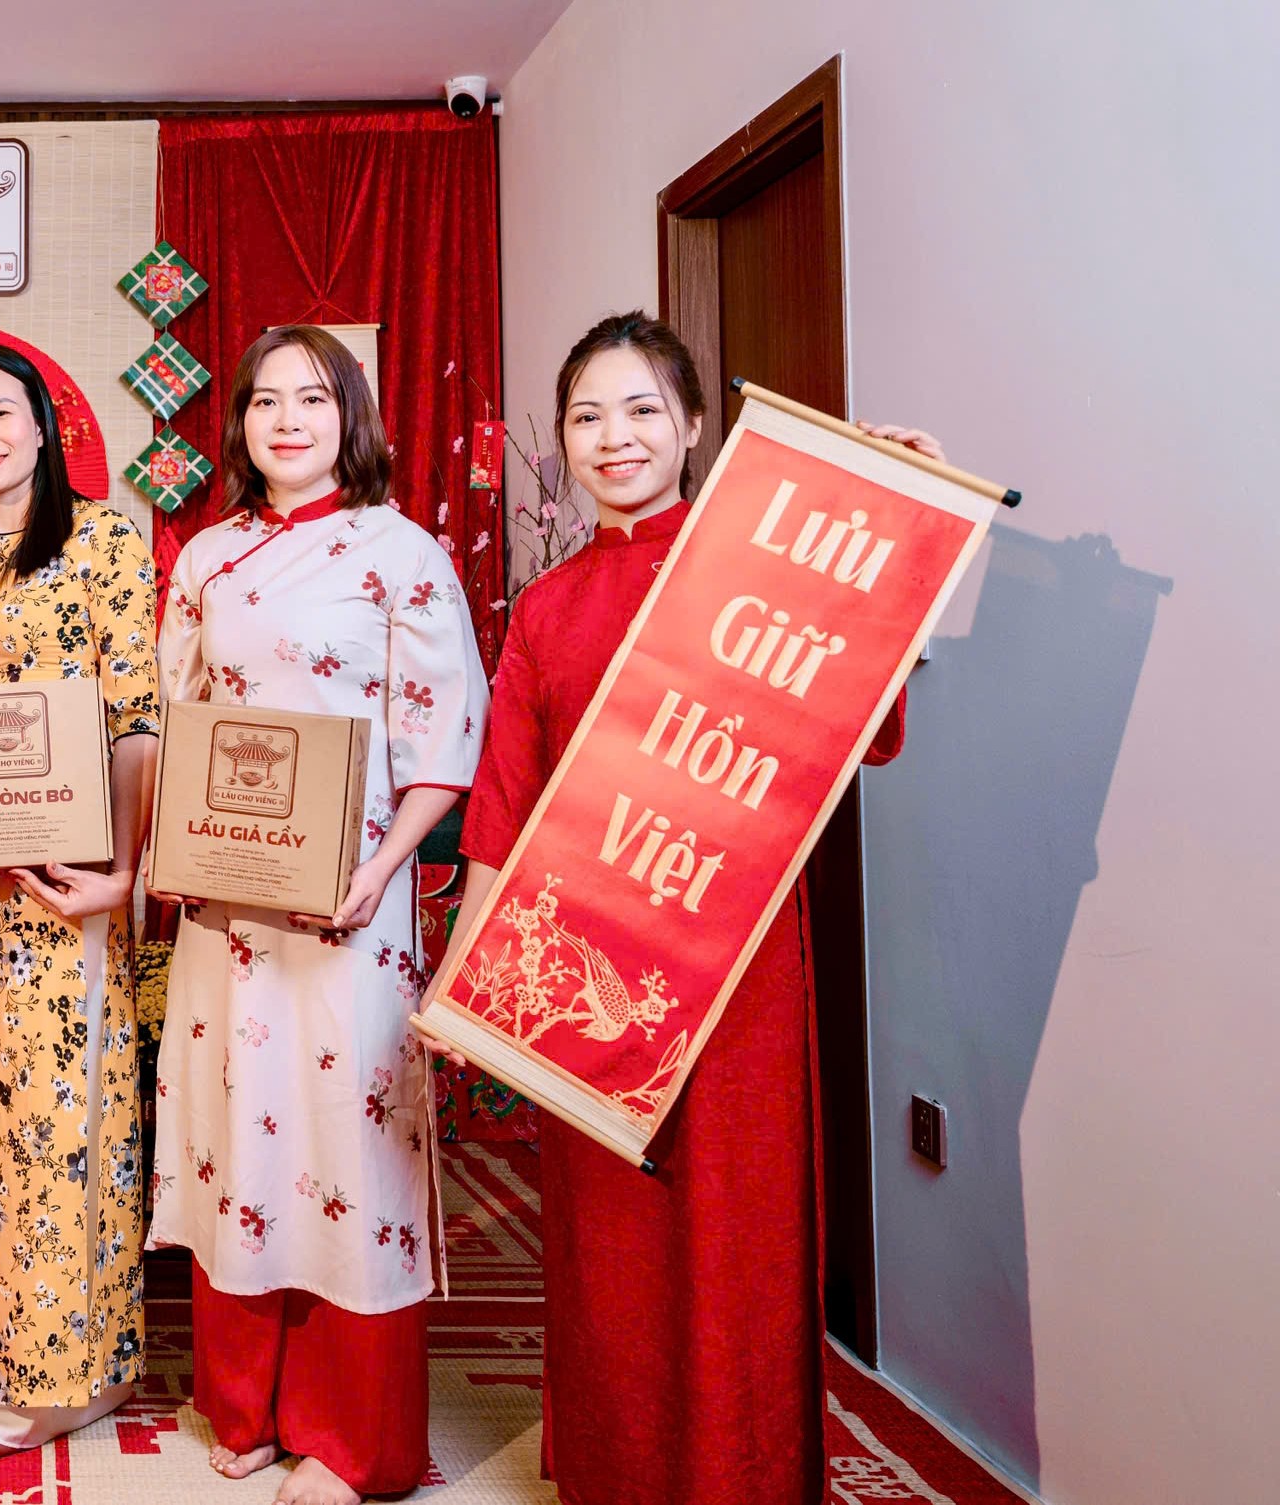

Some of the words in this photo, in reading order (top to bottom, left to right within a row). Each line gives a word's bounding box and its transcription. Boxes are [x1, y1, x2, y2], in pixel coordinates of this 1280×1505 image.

[749, 478, 896, 594] Lưu
[709, 594, 847, 699] Giữ
[46, 784, 74, 803] BÒ
[637, 689, 780, 811] Hồn
[187, 815, 226, 838] LẨU
[229, 823, 262, 843] GIẢ
[266, 825, 307, 849] CẦY
[597, 792, 729, 914] Việt
